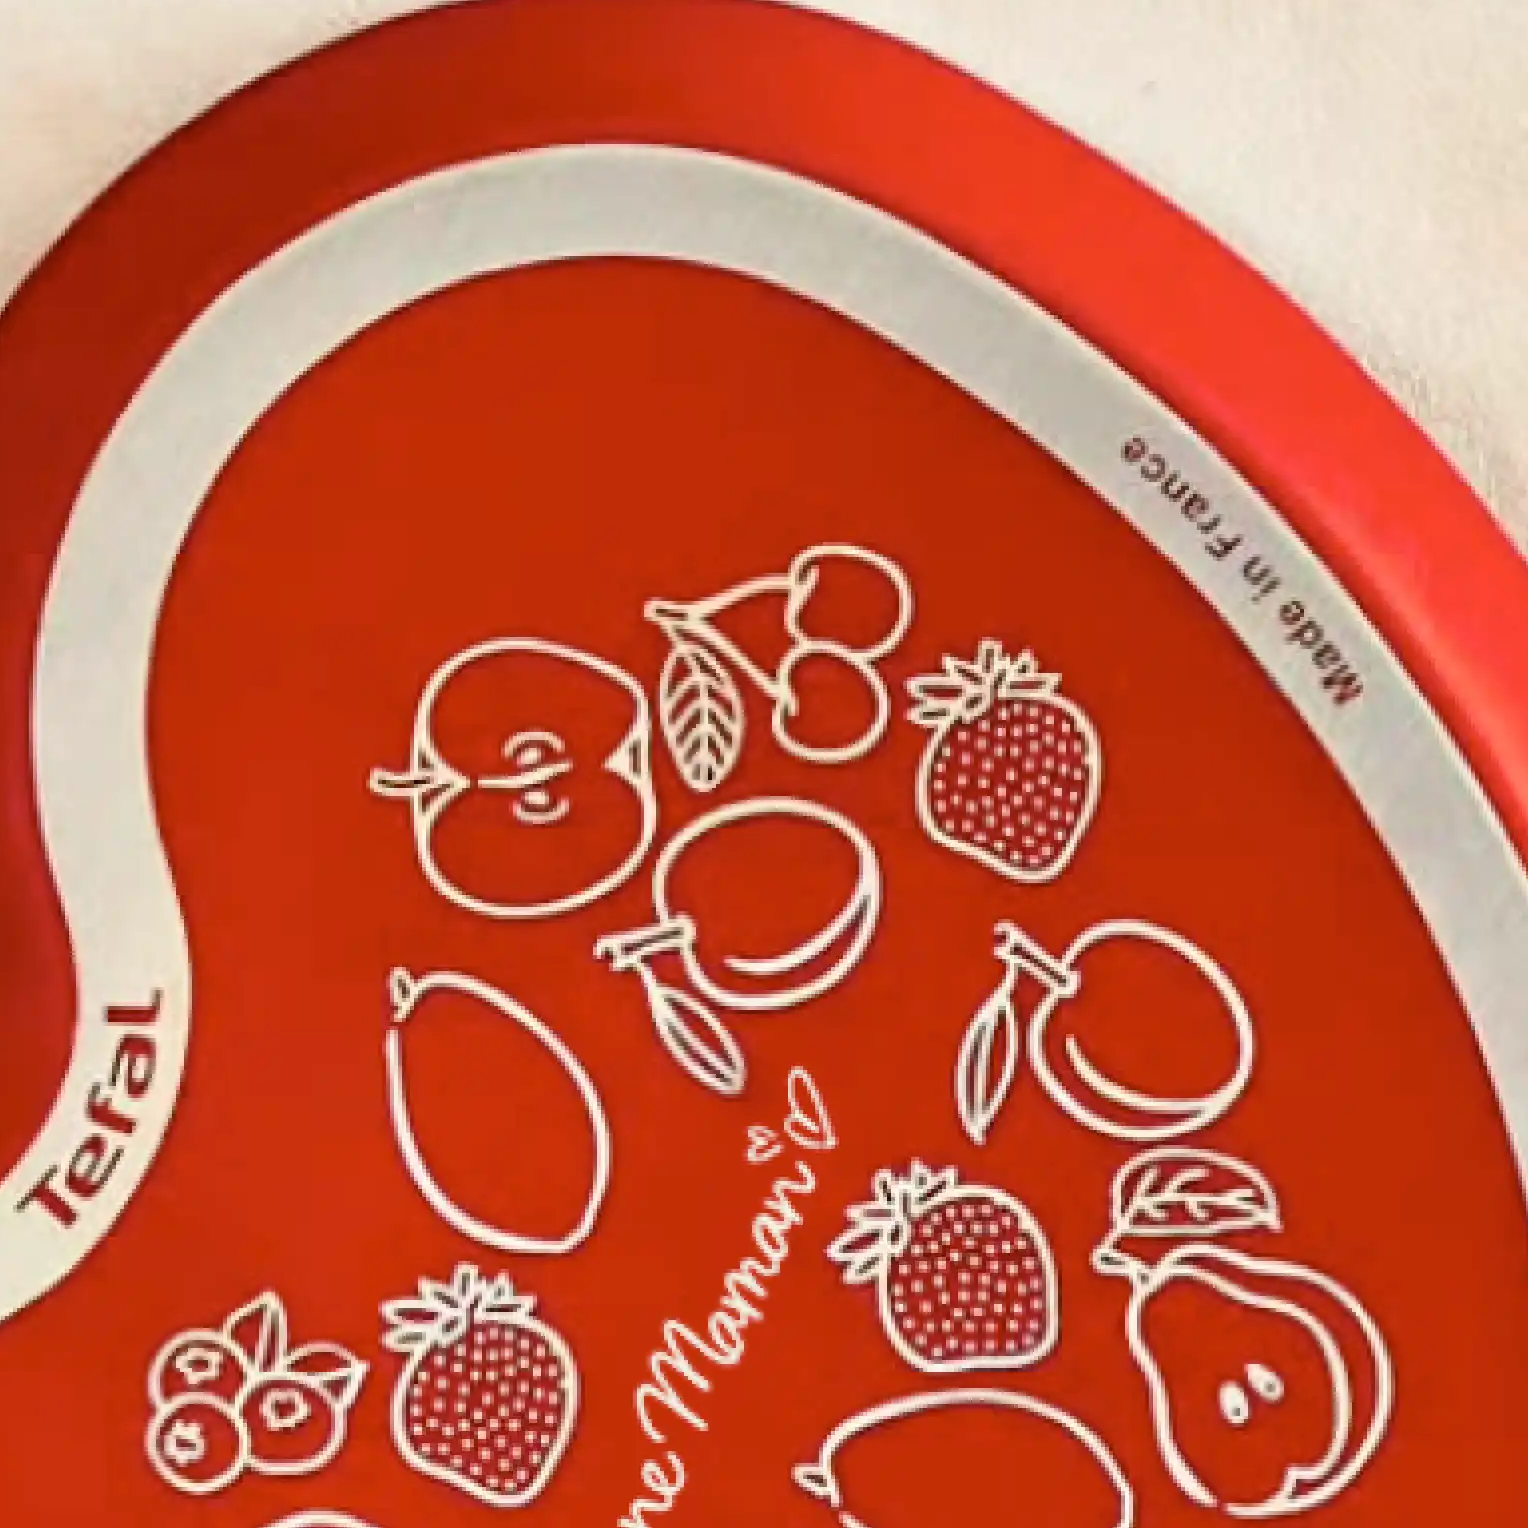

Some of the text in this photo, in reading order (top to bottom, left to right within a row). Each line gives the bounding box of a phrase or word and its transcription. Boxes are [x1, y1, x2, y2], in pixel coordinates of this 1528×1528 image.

[1121, 436, 1363, 705] Made in France
[14, 987, 164, 1229] Tefal
[634, 1160, 816, 1444] Maman
